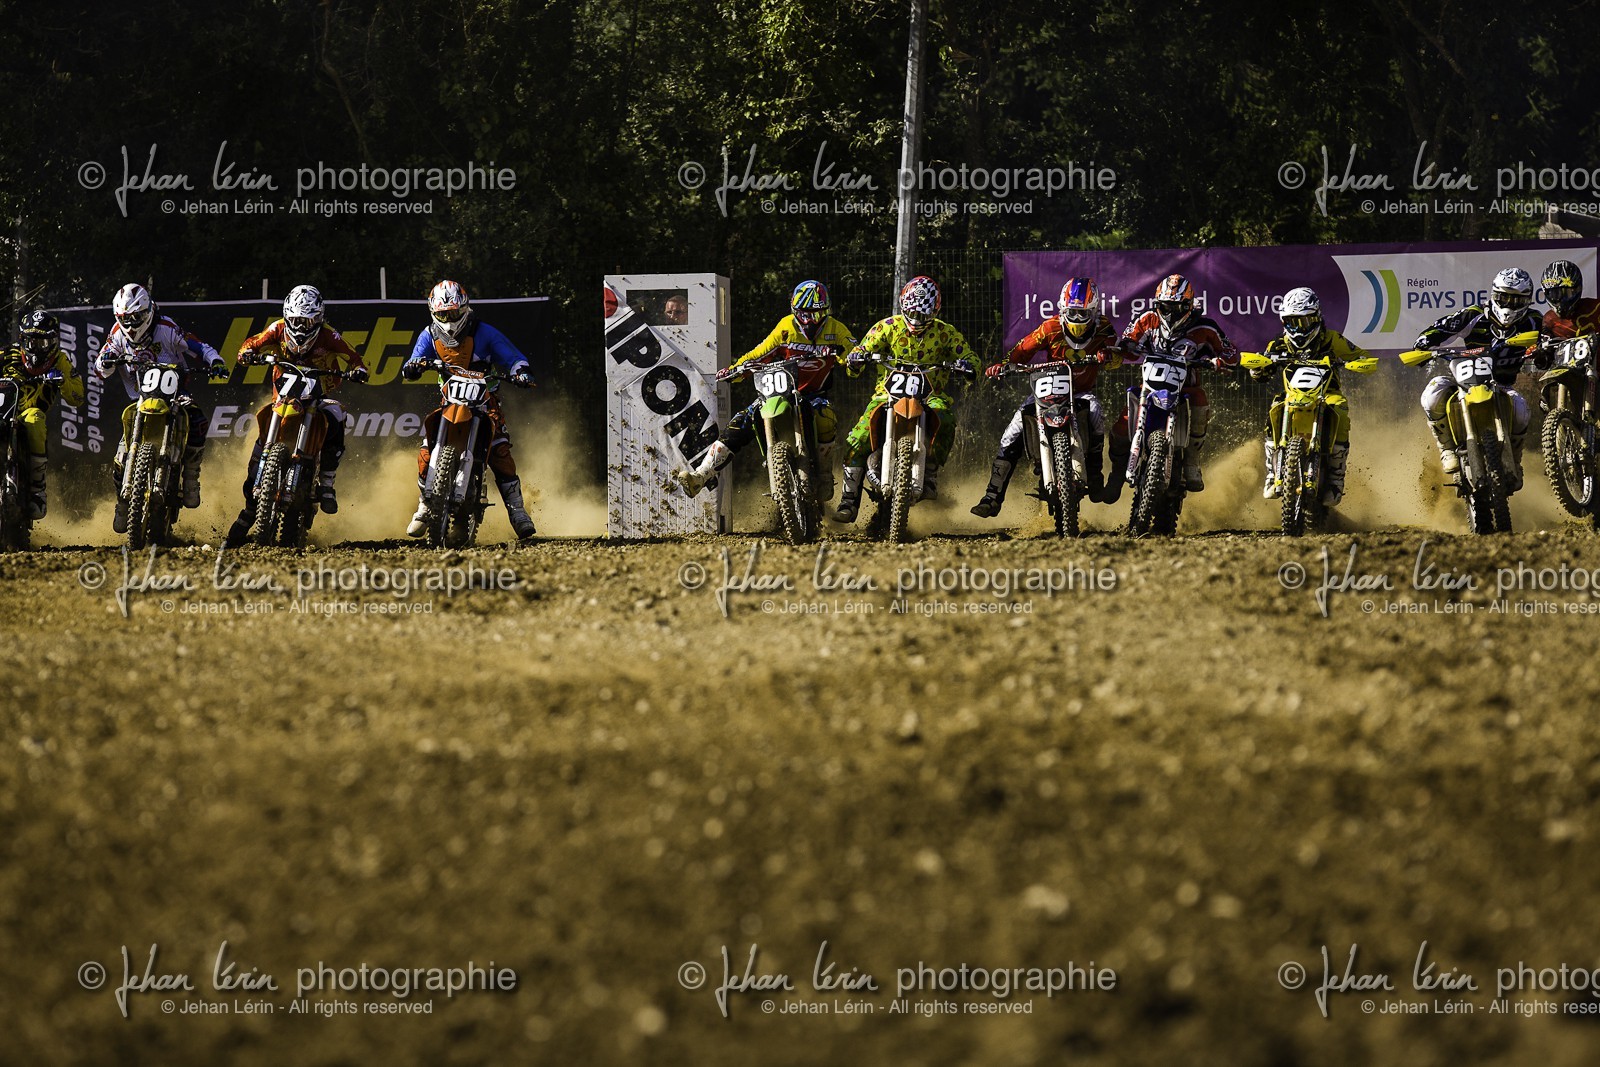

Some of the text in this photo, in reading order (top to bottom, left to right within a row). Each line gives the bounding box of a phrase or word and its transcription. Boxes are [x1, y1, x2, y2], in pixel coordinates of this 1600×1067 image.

[1407, 278, 1439, 288] Région
[1025, 293, 1120, 319] l'eit
[1219, 295, 1283, 316] ouve
[1407, 290, 1488, 309] PAYS DE
[1562, 339, 1589, 363] 18
[87, 322, 105, 454] Location de
[141, 368, 178, 395] 90
[278, 373, 317, 398] 77
[762, 371, 788, 396] 30
[890, 373, 920, 396] 26
[1035, 375, 1070, 398] 65
[1290, 366, 1326, 389] 6
[450, 381, 480, 401] 110
